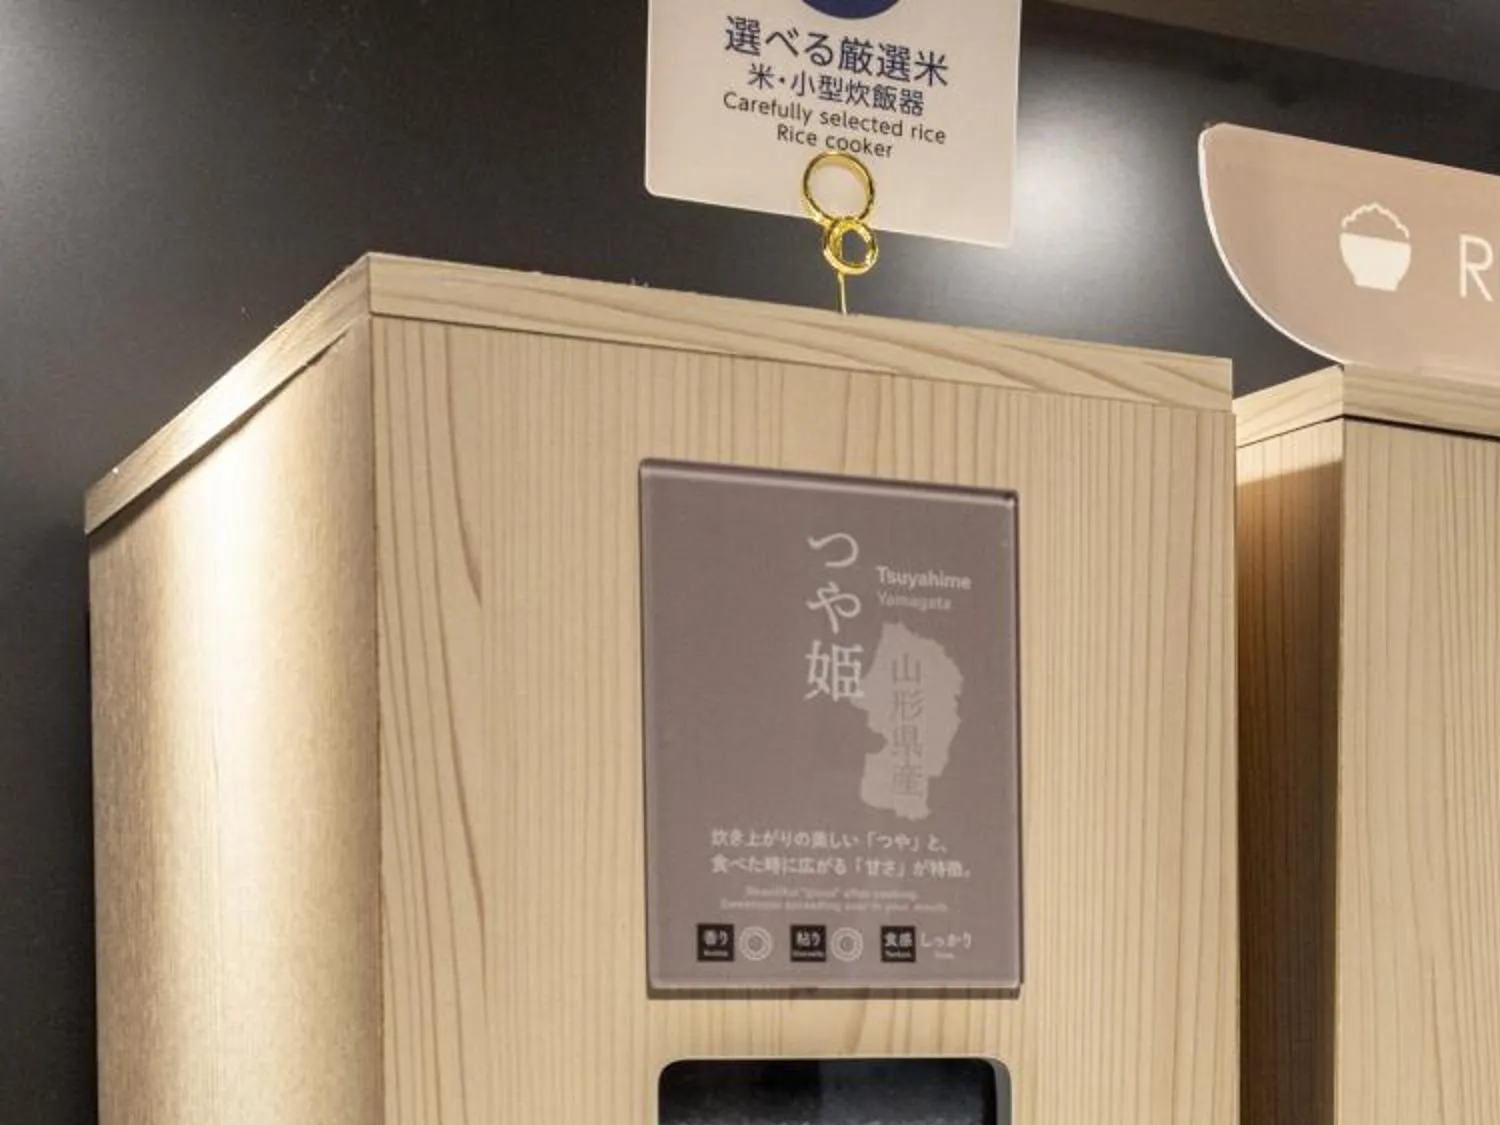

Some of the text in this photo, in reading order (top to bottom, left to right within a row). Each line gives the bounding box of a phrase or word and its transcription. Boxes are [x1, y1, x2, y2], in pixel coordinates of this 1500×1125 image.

[724, 15, 949, 87] 選べる厳選米
[747, 62, 925, 118] 米・小型炊飯器
[723, 91, 947, 145] Carefully selected rice
[776, 123, 893, 159] Rice cooker
[876, 565, 972, 591] Tsuyahime
[804, 532, 865, 703] つや姫
